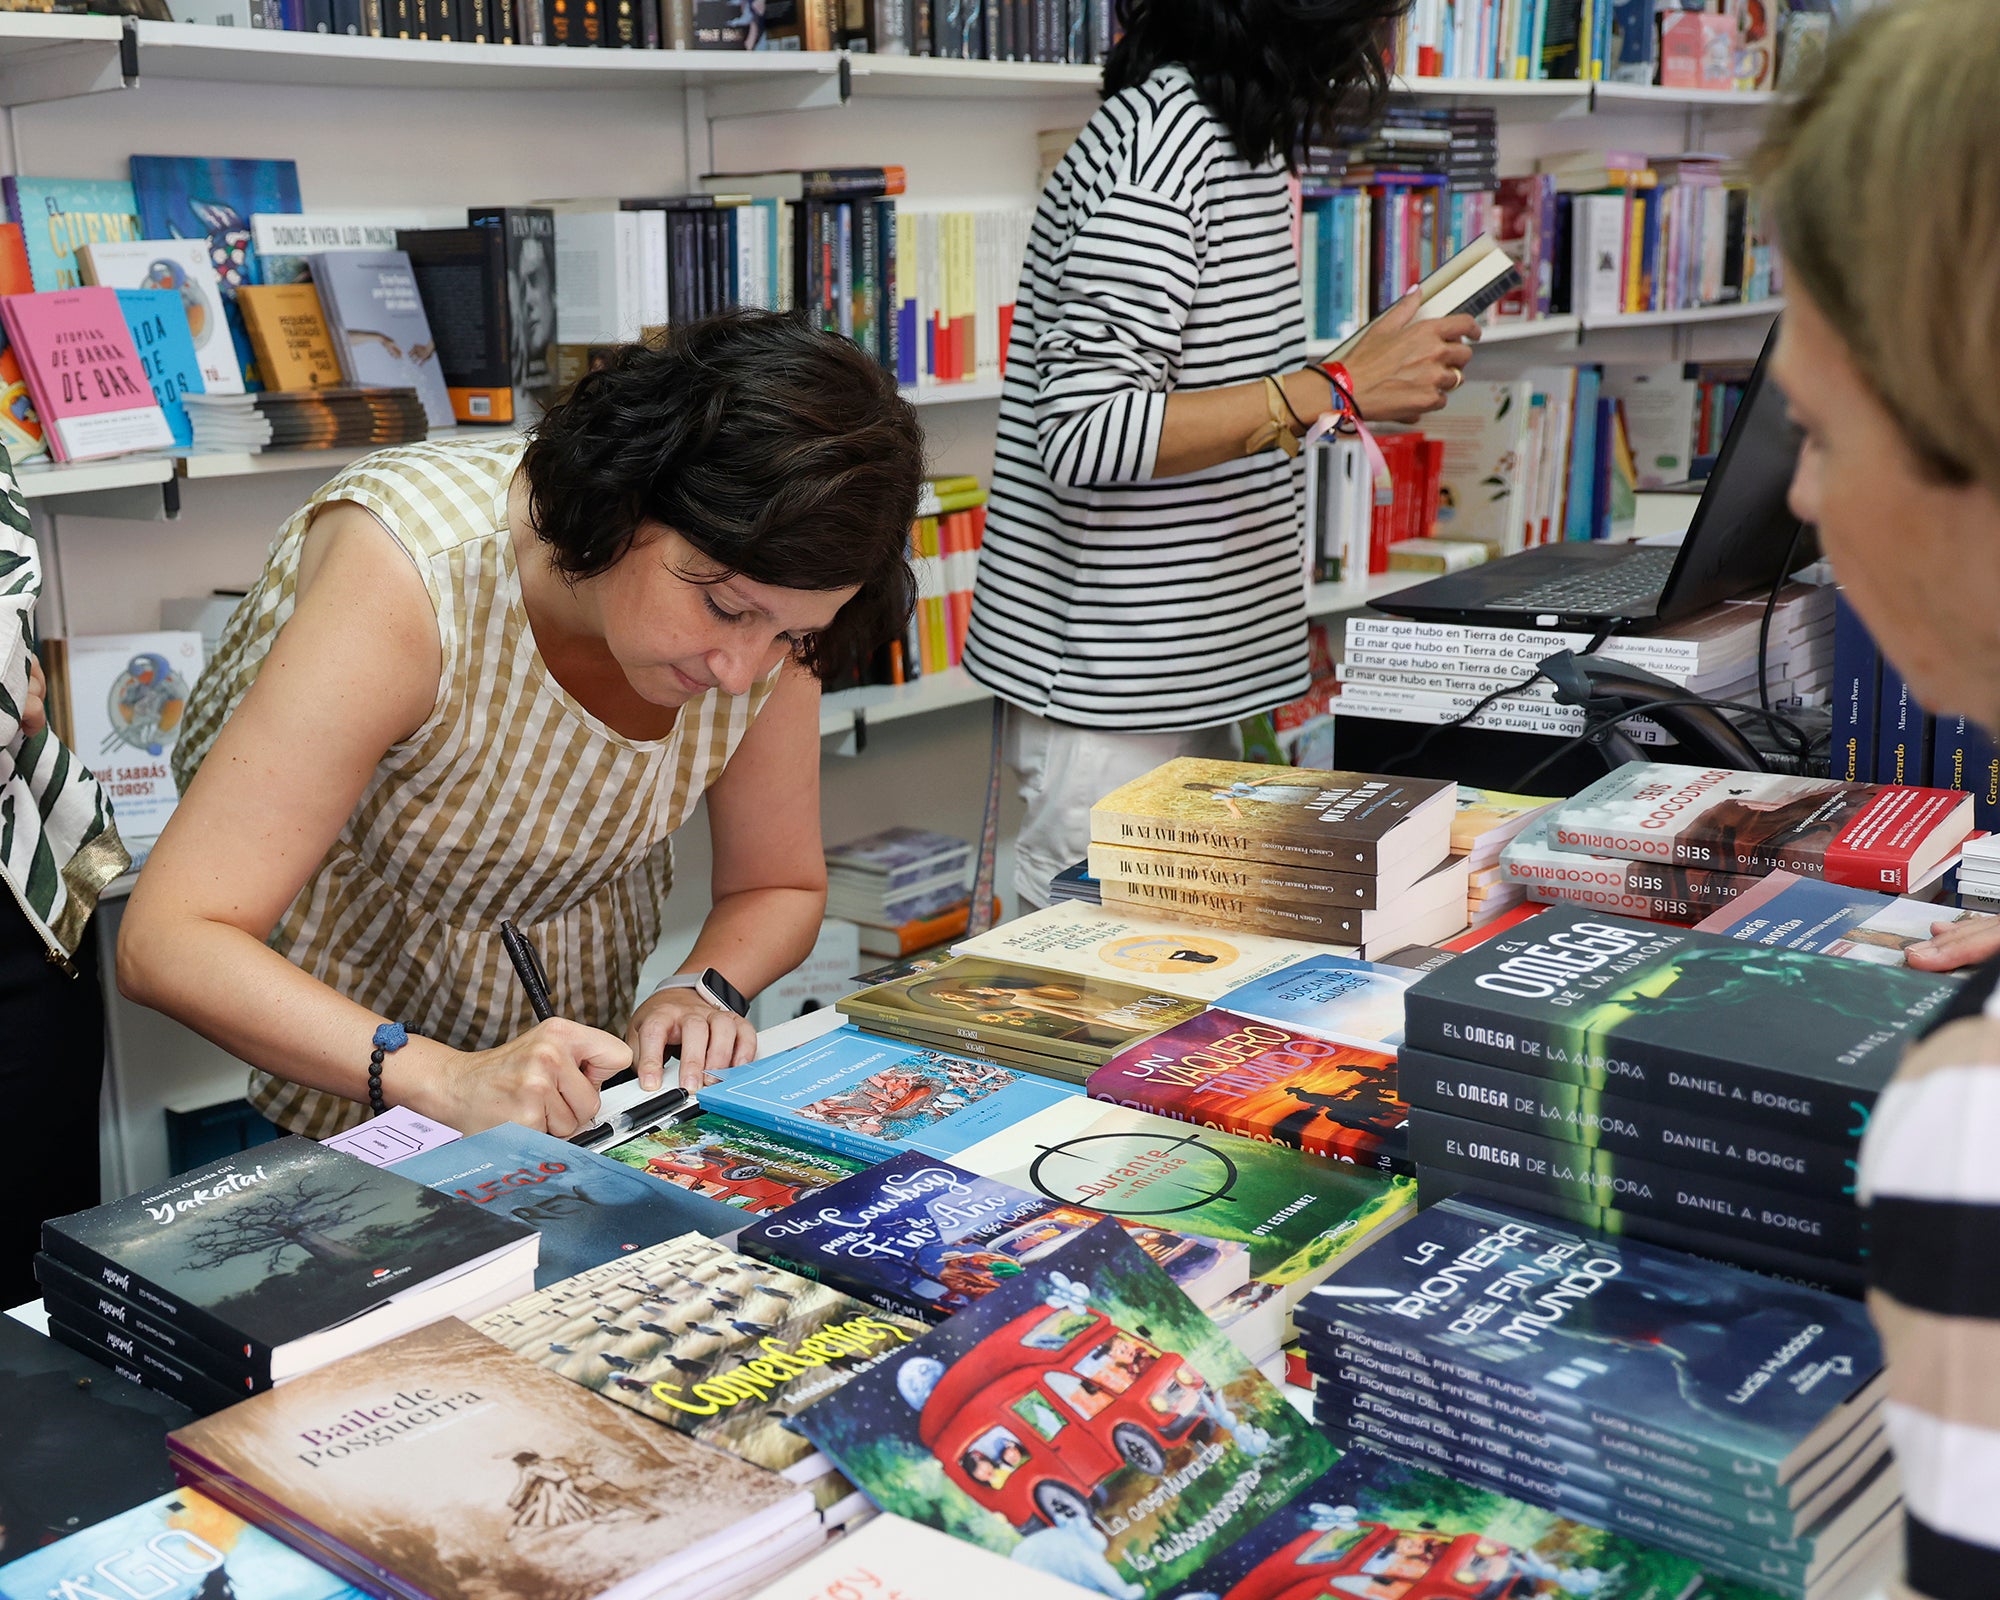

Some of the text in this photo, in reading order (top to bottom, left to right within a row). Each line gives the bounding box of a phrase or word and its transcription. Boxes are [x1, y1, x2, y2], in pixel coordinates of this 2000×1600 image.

[52, 351, 69, 367] DE
[62, 368, 140, 402] DE BAR
[1355, 622, 1566, 646] El mar que hubo en Tierra de Campos
[1355, 638, 1364, 646] El
[1368, 640, 1388, 650] mar
[1392, 642, 1412, 654] que
[1415, 641, 1442, 652] hubo
[1447, 645, 1460, 654] en
[1464, 645, 1496, 658] Tierra
[1500, 648, 1512, 658] de
[1346, 668, 1354, 678] El
[1358, 672, 1376, 680] mar
[1379, 673, 1399, 685] que
[1400, 672, 1427, 684] hubo
[1430, 677, 1442, 686] en
[1446, 677, 1478, 689] Tierra
[1480, 680, 1492, 690] de
[1354, 654, 1362, 662] El
[1366, 656, 1386, 665] mar
[1390, 658, 1410, 670] que
[1412, 658, 1438, 669] hubo
[1442, 662, 1455, 670] en
[1458, 662, 1490, 674] Tierra
[1494, 665, 1508, 674] de
[1666, 663, 1690, 672] Monge
[1845, 678, 1859, 782] Gerardo Marco Porras
[1633, 784, 1672, 801] SEIS
[1640, 770, 1733, 828] COCODRILOS
[1986, 759, 2000, 805] Gerardo
[1122, 824, 1248, 850] LA NIÑA QUE HAY EN MÍ
[1557, 829, 1711, 861] SEIS COCODRILOS
[1510, 863, 1663, 890] SEIS COCODRILOS
[1738, 852, 1824, 872] ABLO DEL RÍO
[1690, 882, 1738, 896] DEL RÍO
[1002, 924, 1058, 946] Me hice
[1020, 923, 1083, 951] escritor
[1064, 922, 1130, 951] dibujar
[1414, 952, 1458, 972] BOLSILLO
[1474, 922, 1656, 999] OMEGA
[1550, 936, 1686, 1006] DE LA AURORA
[1278, 970, 1353, 1002] BUSCANDO
[1310, 977, 1370, 1003] ECLIPSES
[1144, 1025, 1292, 1088] VAQUERO
[1443, 1023, 1645, 1080] EL OMEGA DE LA AURORA
[1836, 1024, 1894, 1065] DANIEL
[1122, 1054, 1174, 1079] UN
[1436, 1080, 1639, 1139] EL OMEGA DE LA AURORA
[1668, 1072, 1812, 1116] DANIEL A. BORGE
[1446, 1140, 1652, 1199] EL OMEGA DE LA AURORA
[1662, 1130, 1806, 1174] DANIEL A. BORGE
[140, 1165, 236, 1206] Alberto García Gil
[1076, 1149, 1170, 1198] Durante
[1138, 1156, 1188, 1190] mirada
[144, 1165, 268, 1225] Yakatai
[765, 1168, 973, 1239] Un Cowboy
[820, 1193, 1007, 1258] para Fin de Año
[970, 1200, 1046, 1239] Tess Curtis
[1250, 1223, 1272, 1238] OTI
[1391, 1222, 1540, 1320] PIONERA
[1404, 1242, 1446, 1266] LA
[1448, 1242, 1586, 1336] DEL FIN DEL
[1498, 1258, 1622, 1345] MUNDO
[1328, 1324, 1537, 1401] LA PIONERA DEL FIN DEL MUNDO
[1335, 1348, 1546, 1424] LA PIONERA DEL FIN DEL MUNDO
[300, 1388, 439, 1446] Baile de
[1094, 1514, 1130, 1536] La
[1127, 1458, 1210, 1522] aventura
[1121, 1548, 1156, 1572] la
